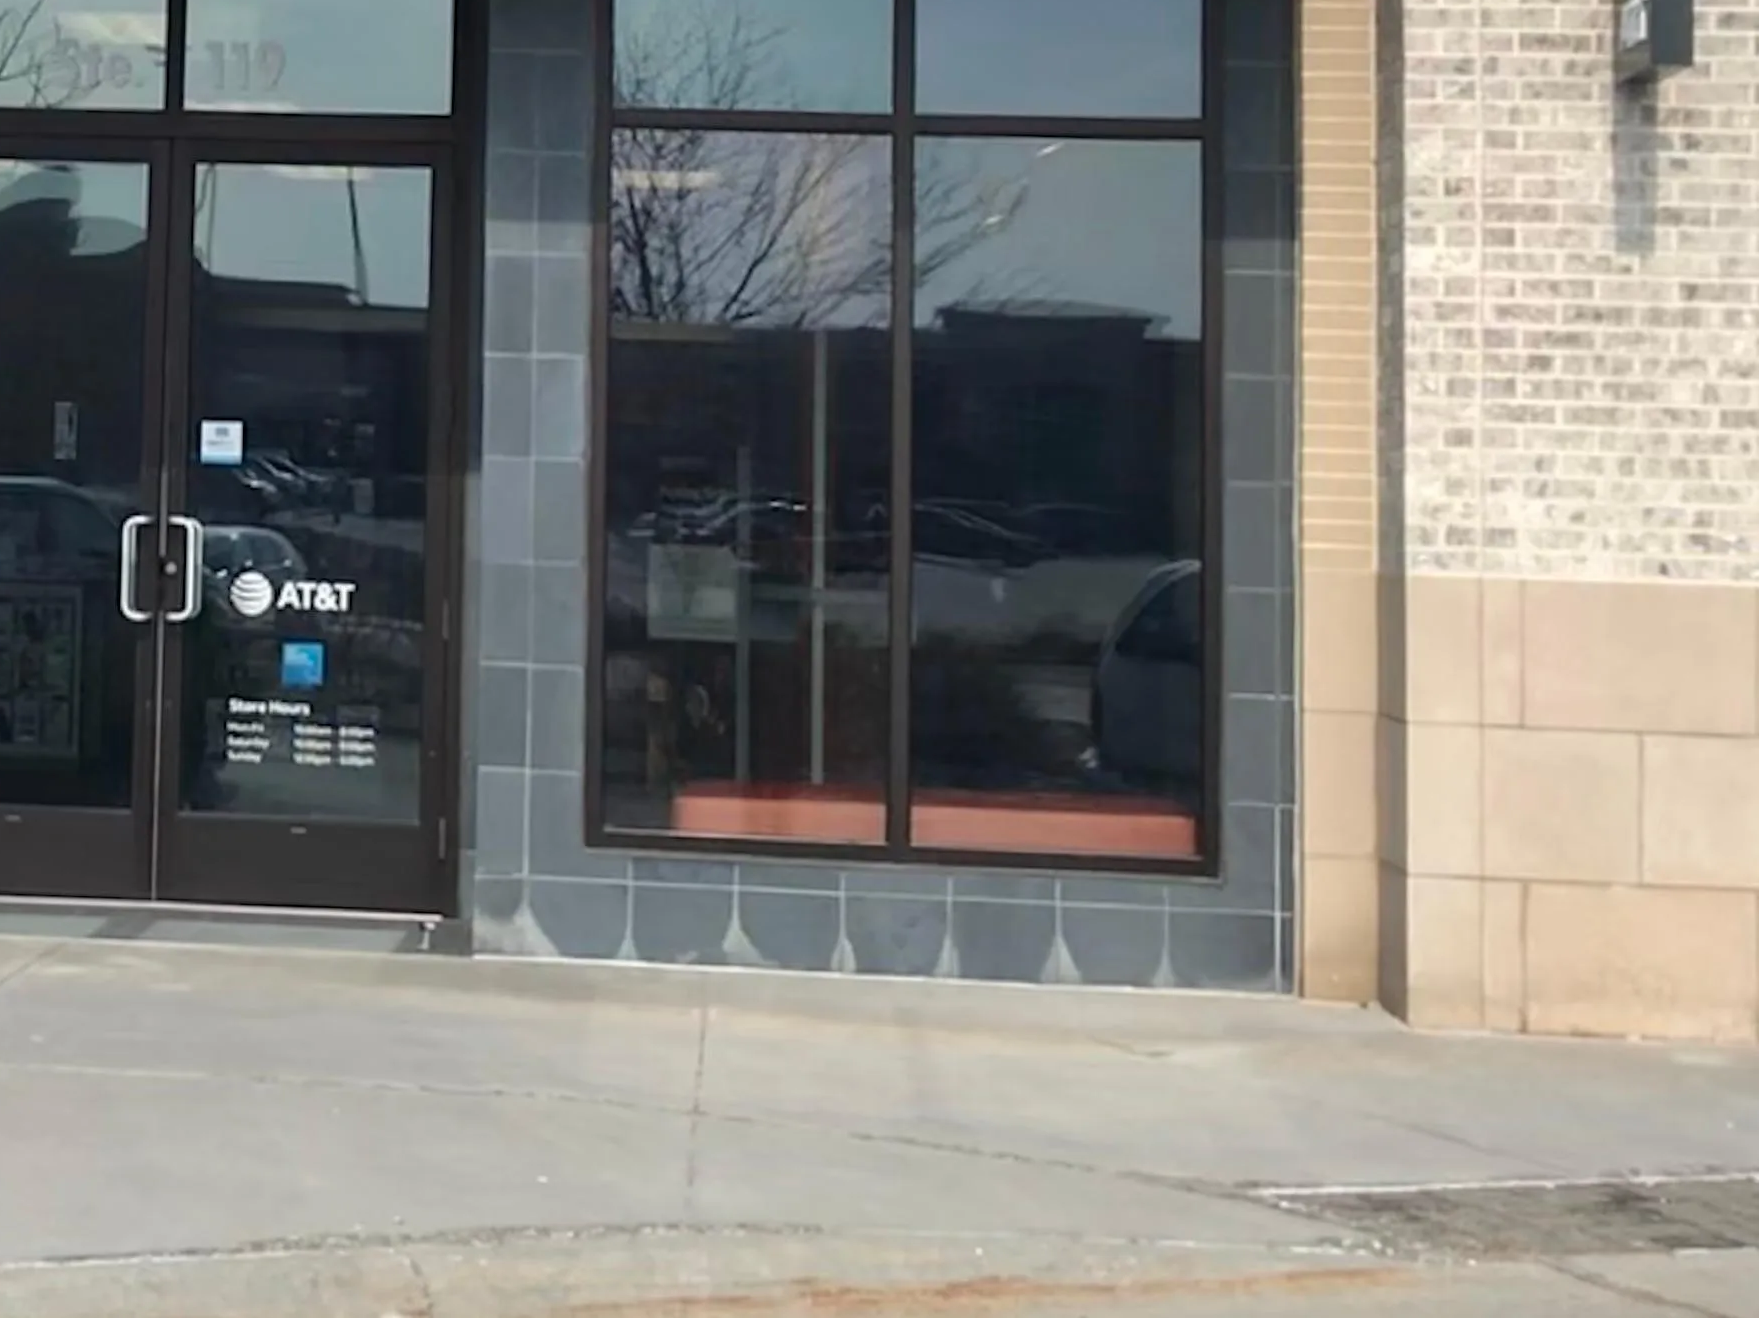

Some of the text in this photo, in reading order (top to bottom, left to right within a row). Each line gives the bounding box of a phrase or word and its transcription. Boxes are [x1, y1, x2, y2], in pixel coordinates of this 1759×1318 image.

[205, 39, 288, 92] 119
[276, 580, 357, 612] AT&T
[229, 697, 311, 717] Store Hours
